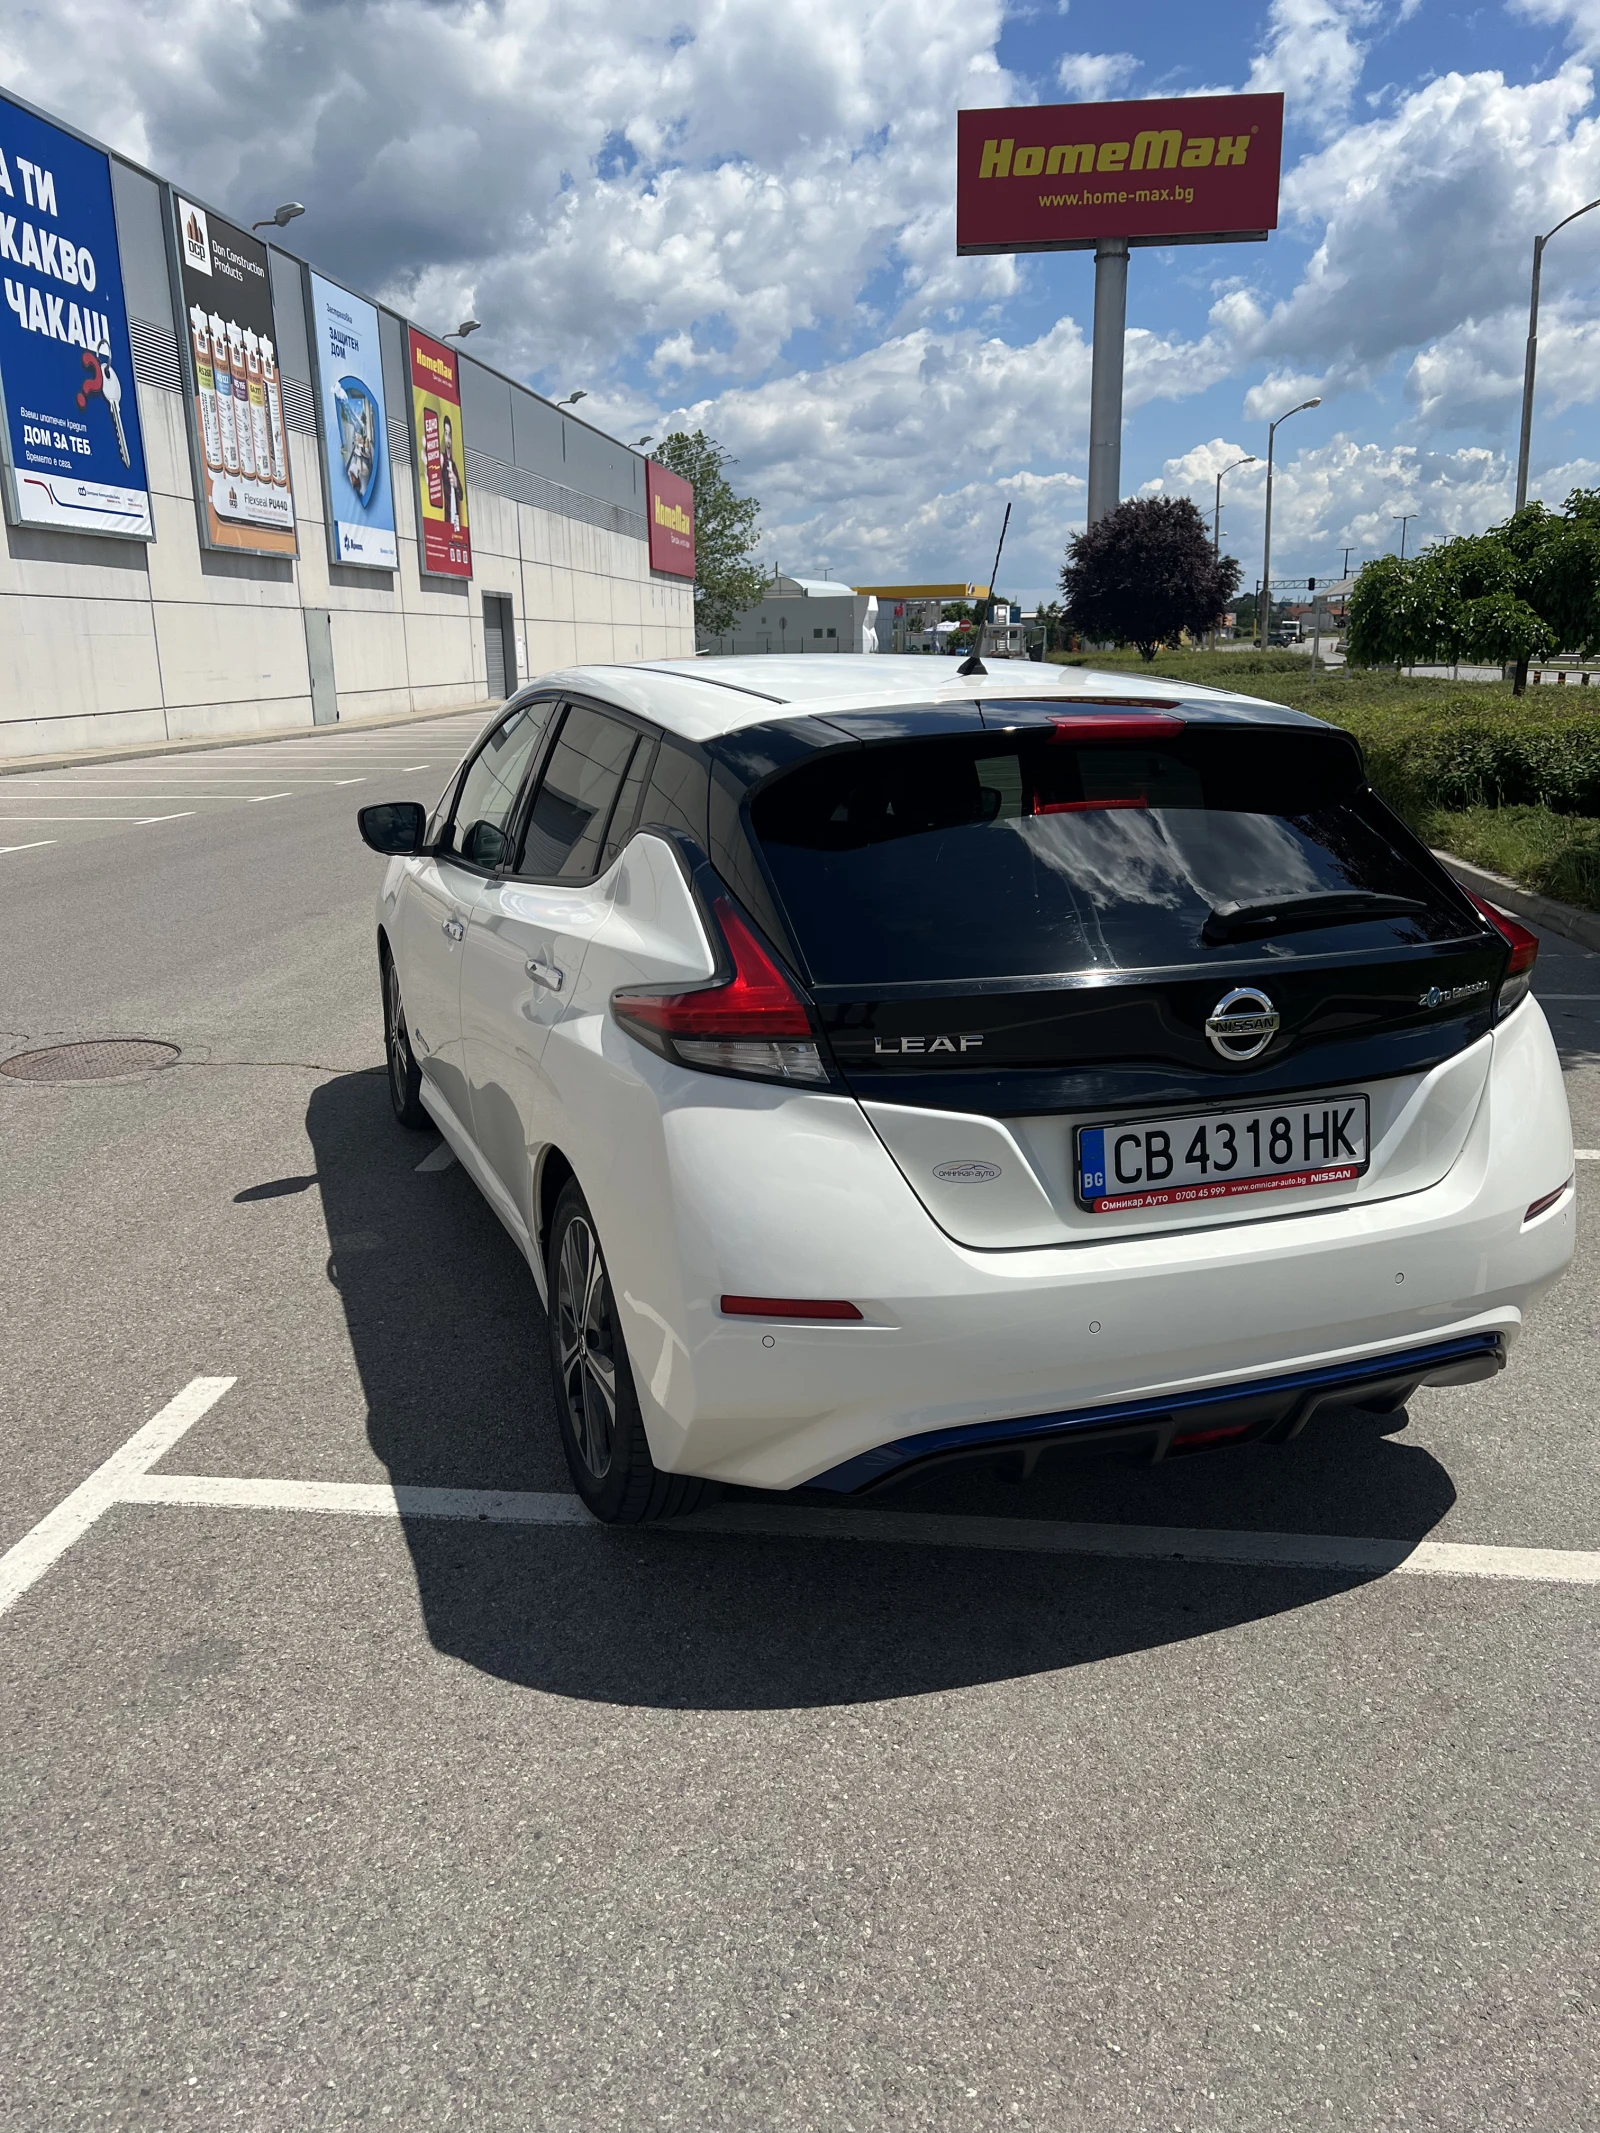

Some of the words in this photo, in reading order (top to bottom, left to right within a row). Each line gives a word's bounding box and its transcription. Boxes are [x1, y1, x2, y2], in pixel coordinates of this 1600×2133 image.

[978, 129, 1251, 178] HomeMax
[16, 155, 58, 217] ТИ
[1039, 185, 1194, 207] www.home-max.bg
[0, 211, 96, 293] КАКВО
[212, 239, 226, 258] Don
[226, 247, 265, 278] Construction
[213, 256, 243, 282] Products
[329, 326, 360, 352] ЗАЩИТЕН
[331, 342, 346, 360] ДОМ
[416, 347, 452, 381] HomeMax
[20, 406, 39, 421] Вземи
[23, 424, 52, 447] ДОМ
[53, 431, 69, 451] ЗА
[25, 450, 53, 465] Времето
[244, 492, 268, 508] Flexseal
[269, 498, 288, 511] PU440
[655, 494, 690, 536] HomeMax
[1215, 1017, 1274, 1033] NISSAN
[874, 1035, 984, 1053] LEAF
[1114, 1131, 1174, 1185] CB
[1185, 1116, 1294, 1174] 4318
[1303, 1107, 1358, 1162] HK
[1084, 1171, 1104, 1188] BG
[1101, 1198, 1144, 1210] Омникар
[1145, 1194, 1168, 1207] Ауто
[1175, 1190, 1196, 1201] 0700
[1198, 1188, 1209, 1198] 45
[1210, 1186, 1226, 1196] 999
[1231, 1177, 1307, 1192] www.omnicar-auto.bg
[1311, 1169, 1351, 1183] NISSAN
